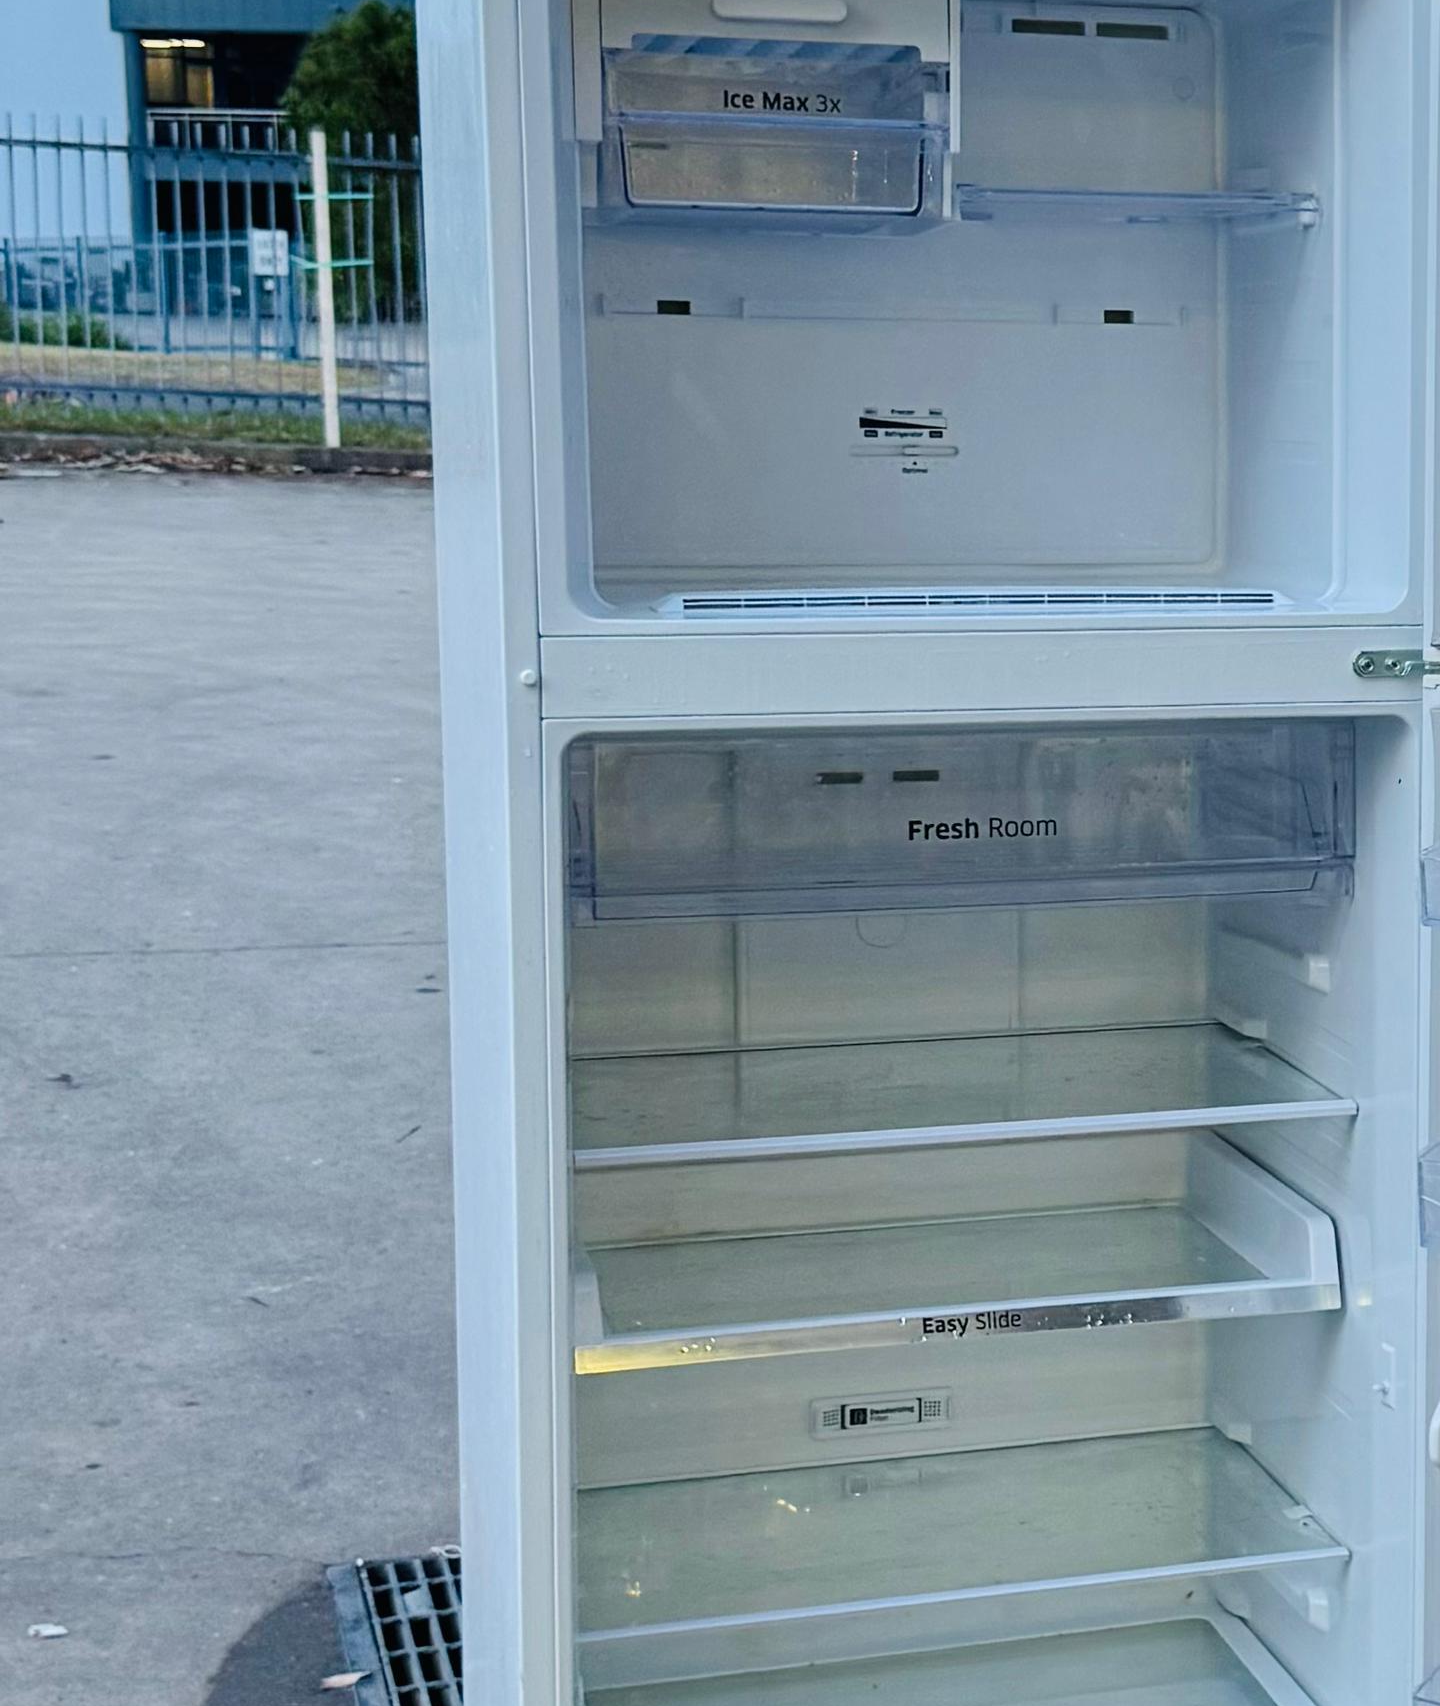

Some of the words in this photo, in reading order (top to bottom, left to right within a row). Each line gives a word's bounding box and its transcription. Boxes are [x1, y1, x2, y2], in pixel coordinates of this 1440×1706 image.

[723, 89, 755, 109] Ice
[762, 91, 809, 112] Max
[816, 94, 841, 113] 3x
[908, 818, 979, 841] Fresh
[989, 817, 1057, 838] Room
[922, 1316, 969, 1337] Easy
[975, 1311, 1022, 1330] Slide
